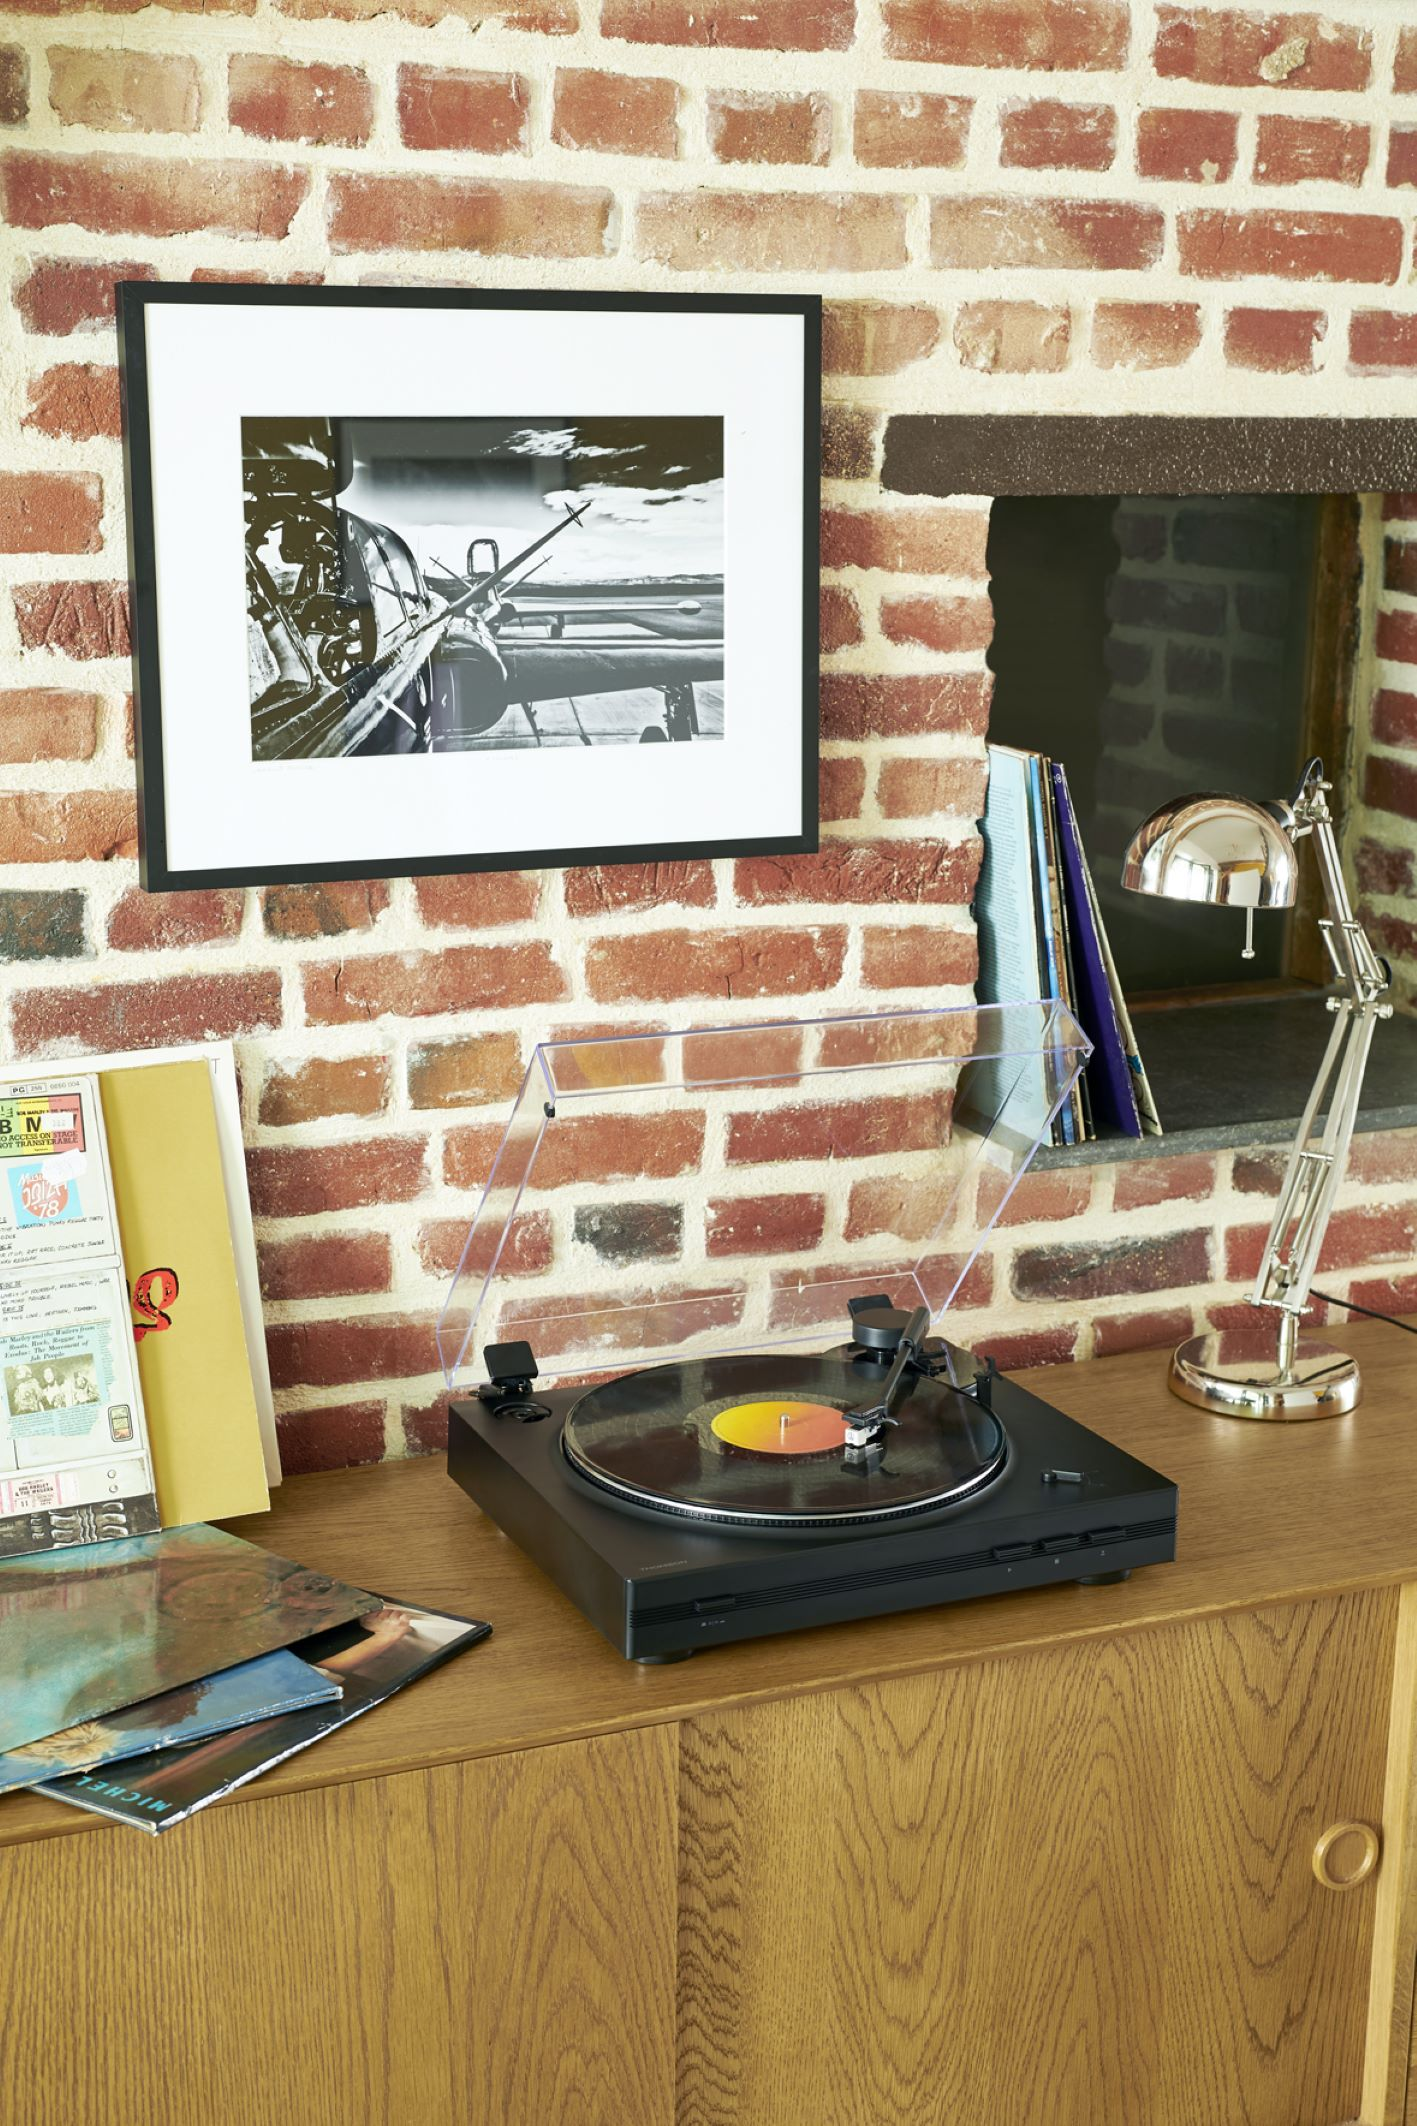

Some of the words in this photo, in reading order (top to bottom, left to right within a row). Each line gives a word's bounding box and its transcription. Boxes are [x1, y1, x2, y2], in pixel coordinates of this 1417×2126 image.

[9, 1133, 38, 1142] ACCESS
[53, 1130, 79, 1139] STAGE
[15, 1137, 79, 1148] TRANSFERABLE
[75, 1775, 173, 1813] MICHEL
